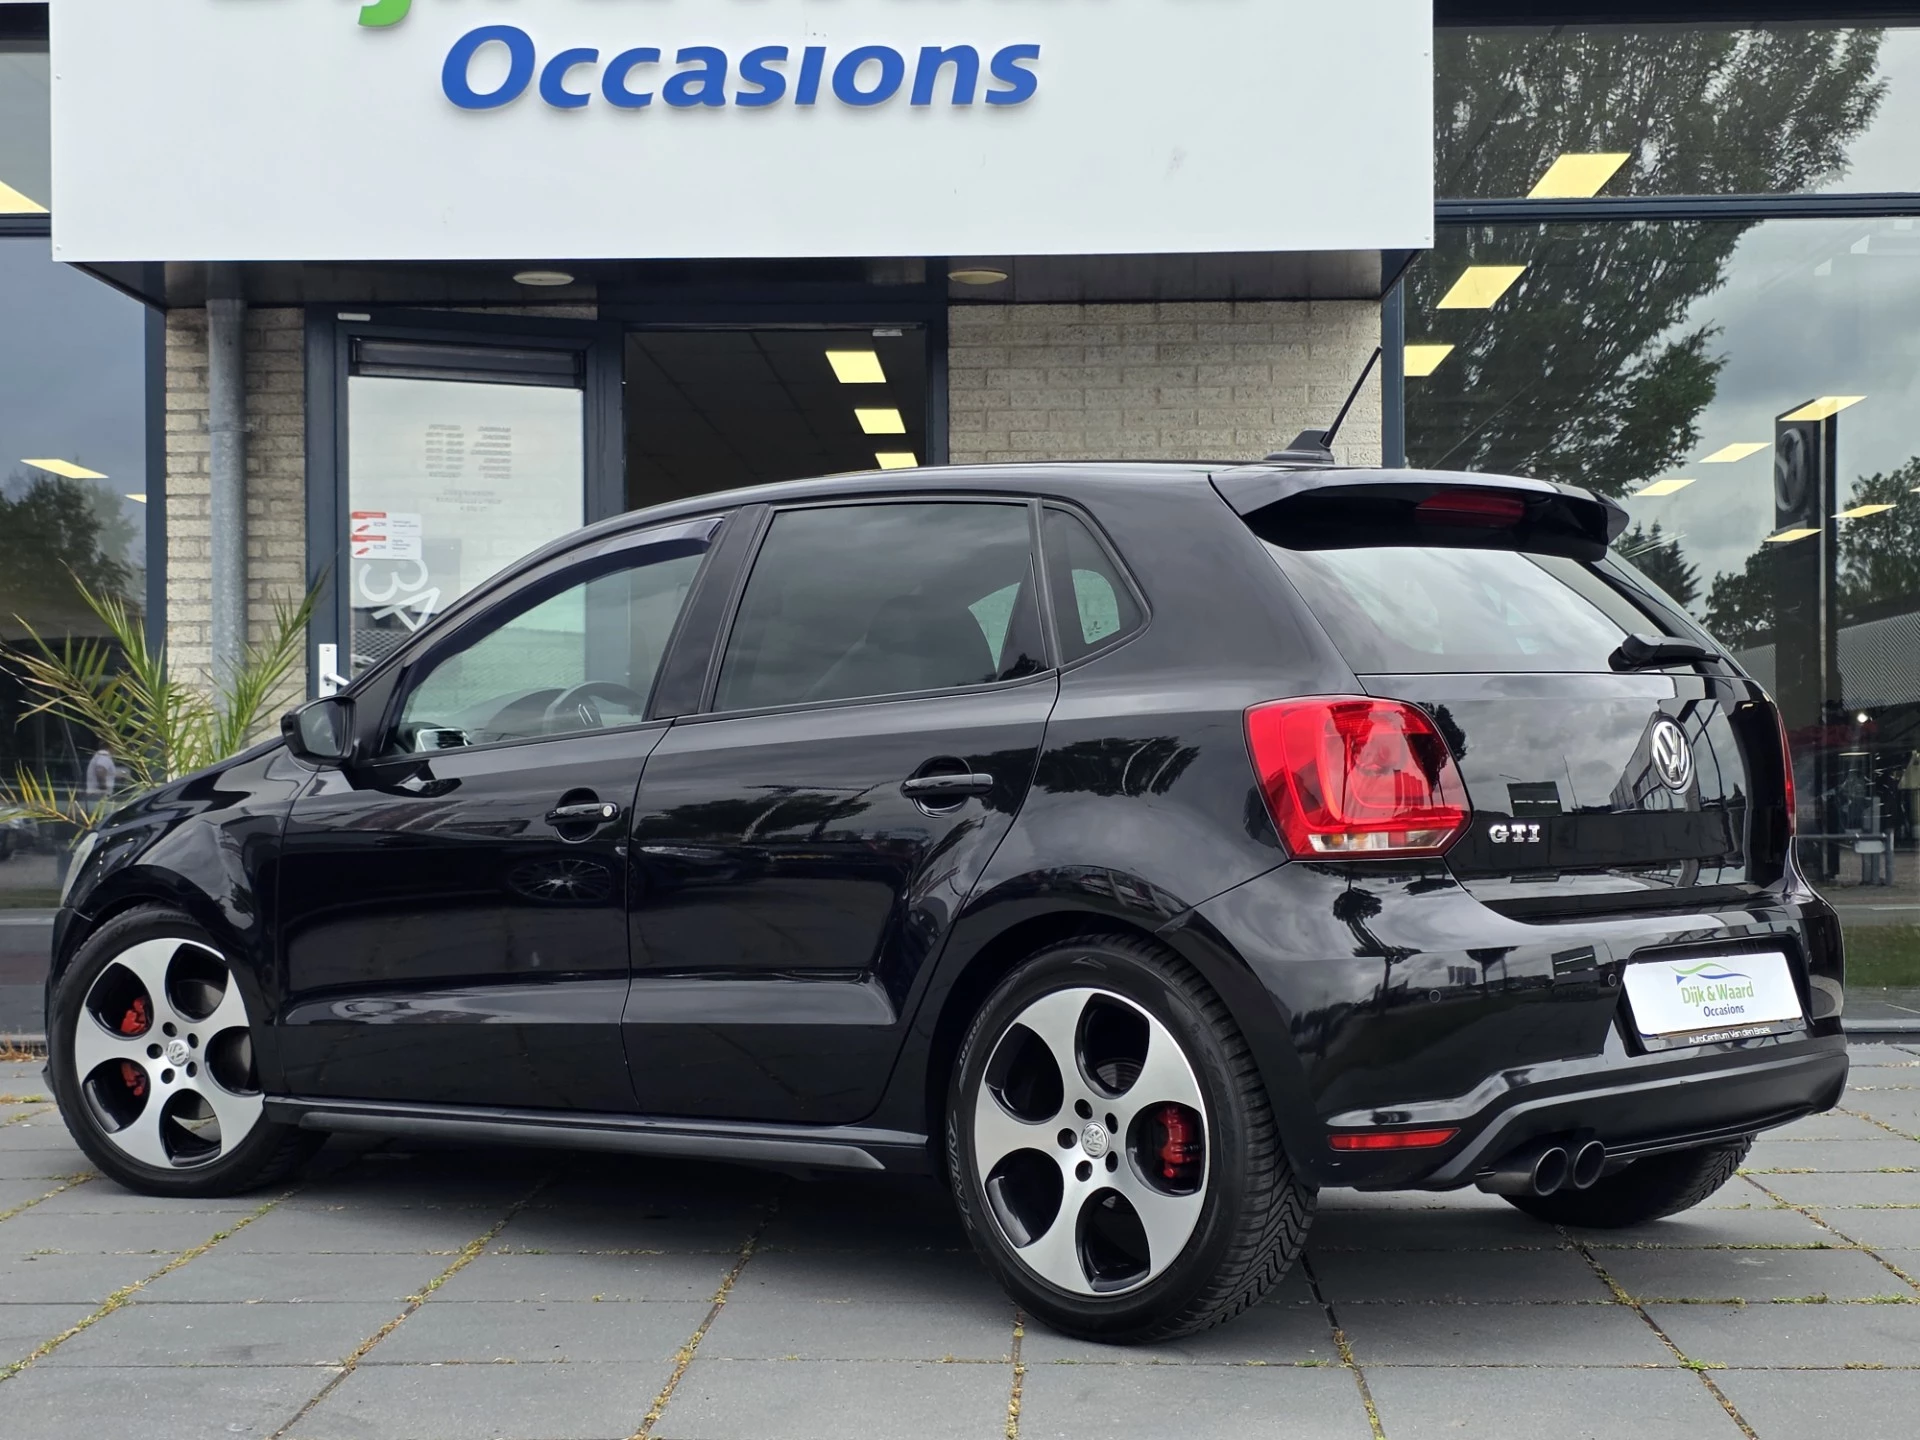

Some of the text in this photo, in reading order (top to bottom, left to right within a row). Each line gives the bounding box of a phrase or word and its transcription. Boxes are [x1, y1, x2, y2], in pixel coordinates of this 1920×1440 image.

[442, 26, 1040, 109] Occasions
[1489, 824, 1541, 844] GTI
[1681, 982, 1754, 1007] Dijk & Waard
[1703, 1004, 1745, 1018] Occasions
